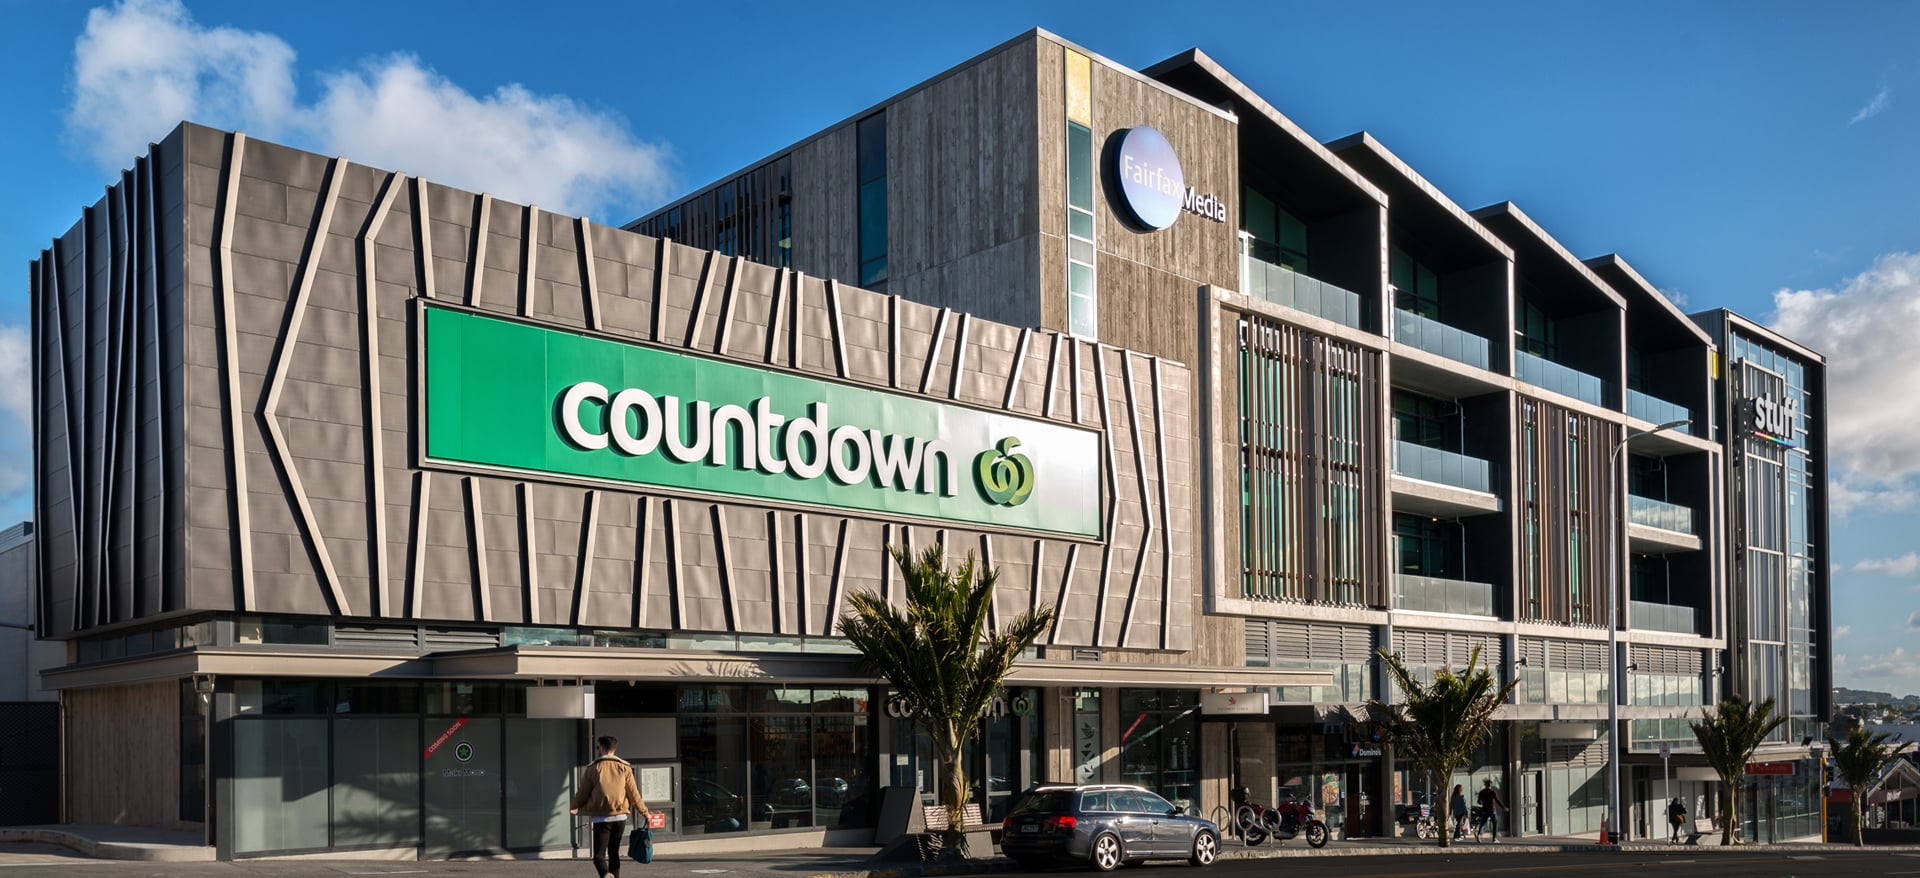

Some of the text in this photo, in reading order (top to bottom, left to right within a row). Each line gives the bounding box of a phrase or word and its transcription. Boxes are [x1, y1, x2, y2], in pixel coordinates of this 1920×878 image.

[1124, 154, 1226, 222] Fairfax Media
[562, 381, 958, 497] countdown
[1755, 392, 1798, 440] stuff
[428, 721, 461, 752] COMING SOON
